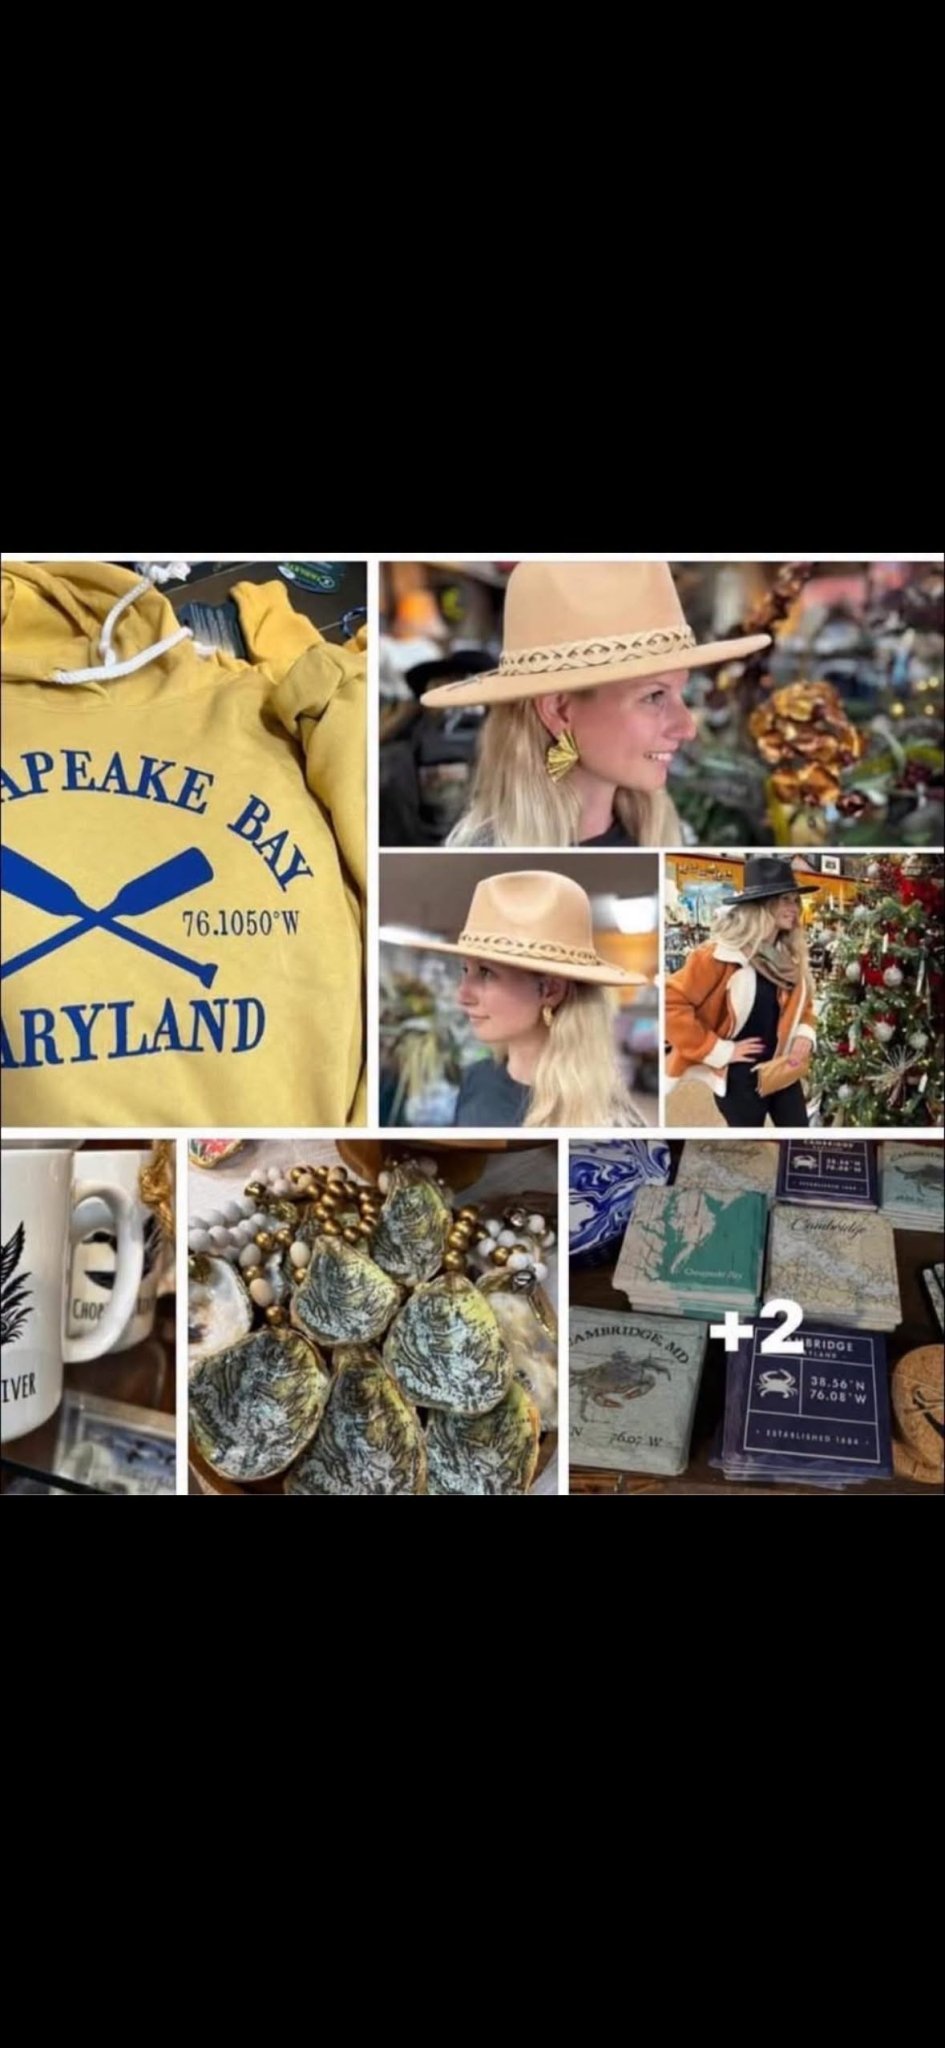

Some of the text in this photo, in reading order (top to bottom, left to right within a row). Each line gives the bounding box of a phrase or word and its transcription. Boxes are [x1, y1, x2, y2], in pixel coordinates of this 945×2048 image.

[226, 795, 314, 893] BAY
[182, 910, 300, 937] 76.1050°W
[790, 1217, 868, 1239] Cambridge
[664, 1341, 690, 1364] MD
[1, 1372, 37, 1403] IVER
